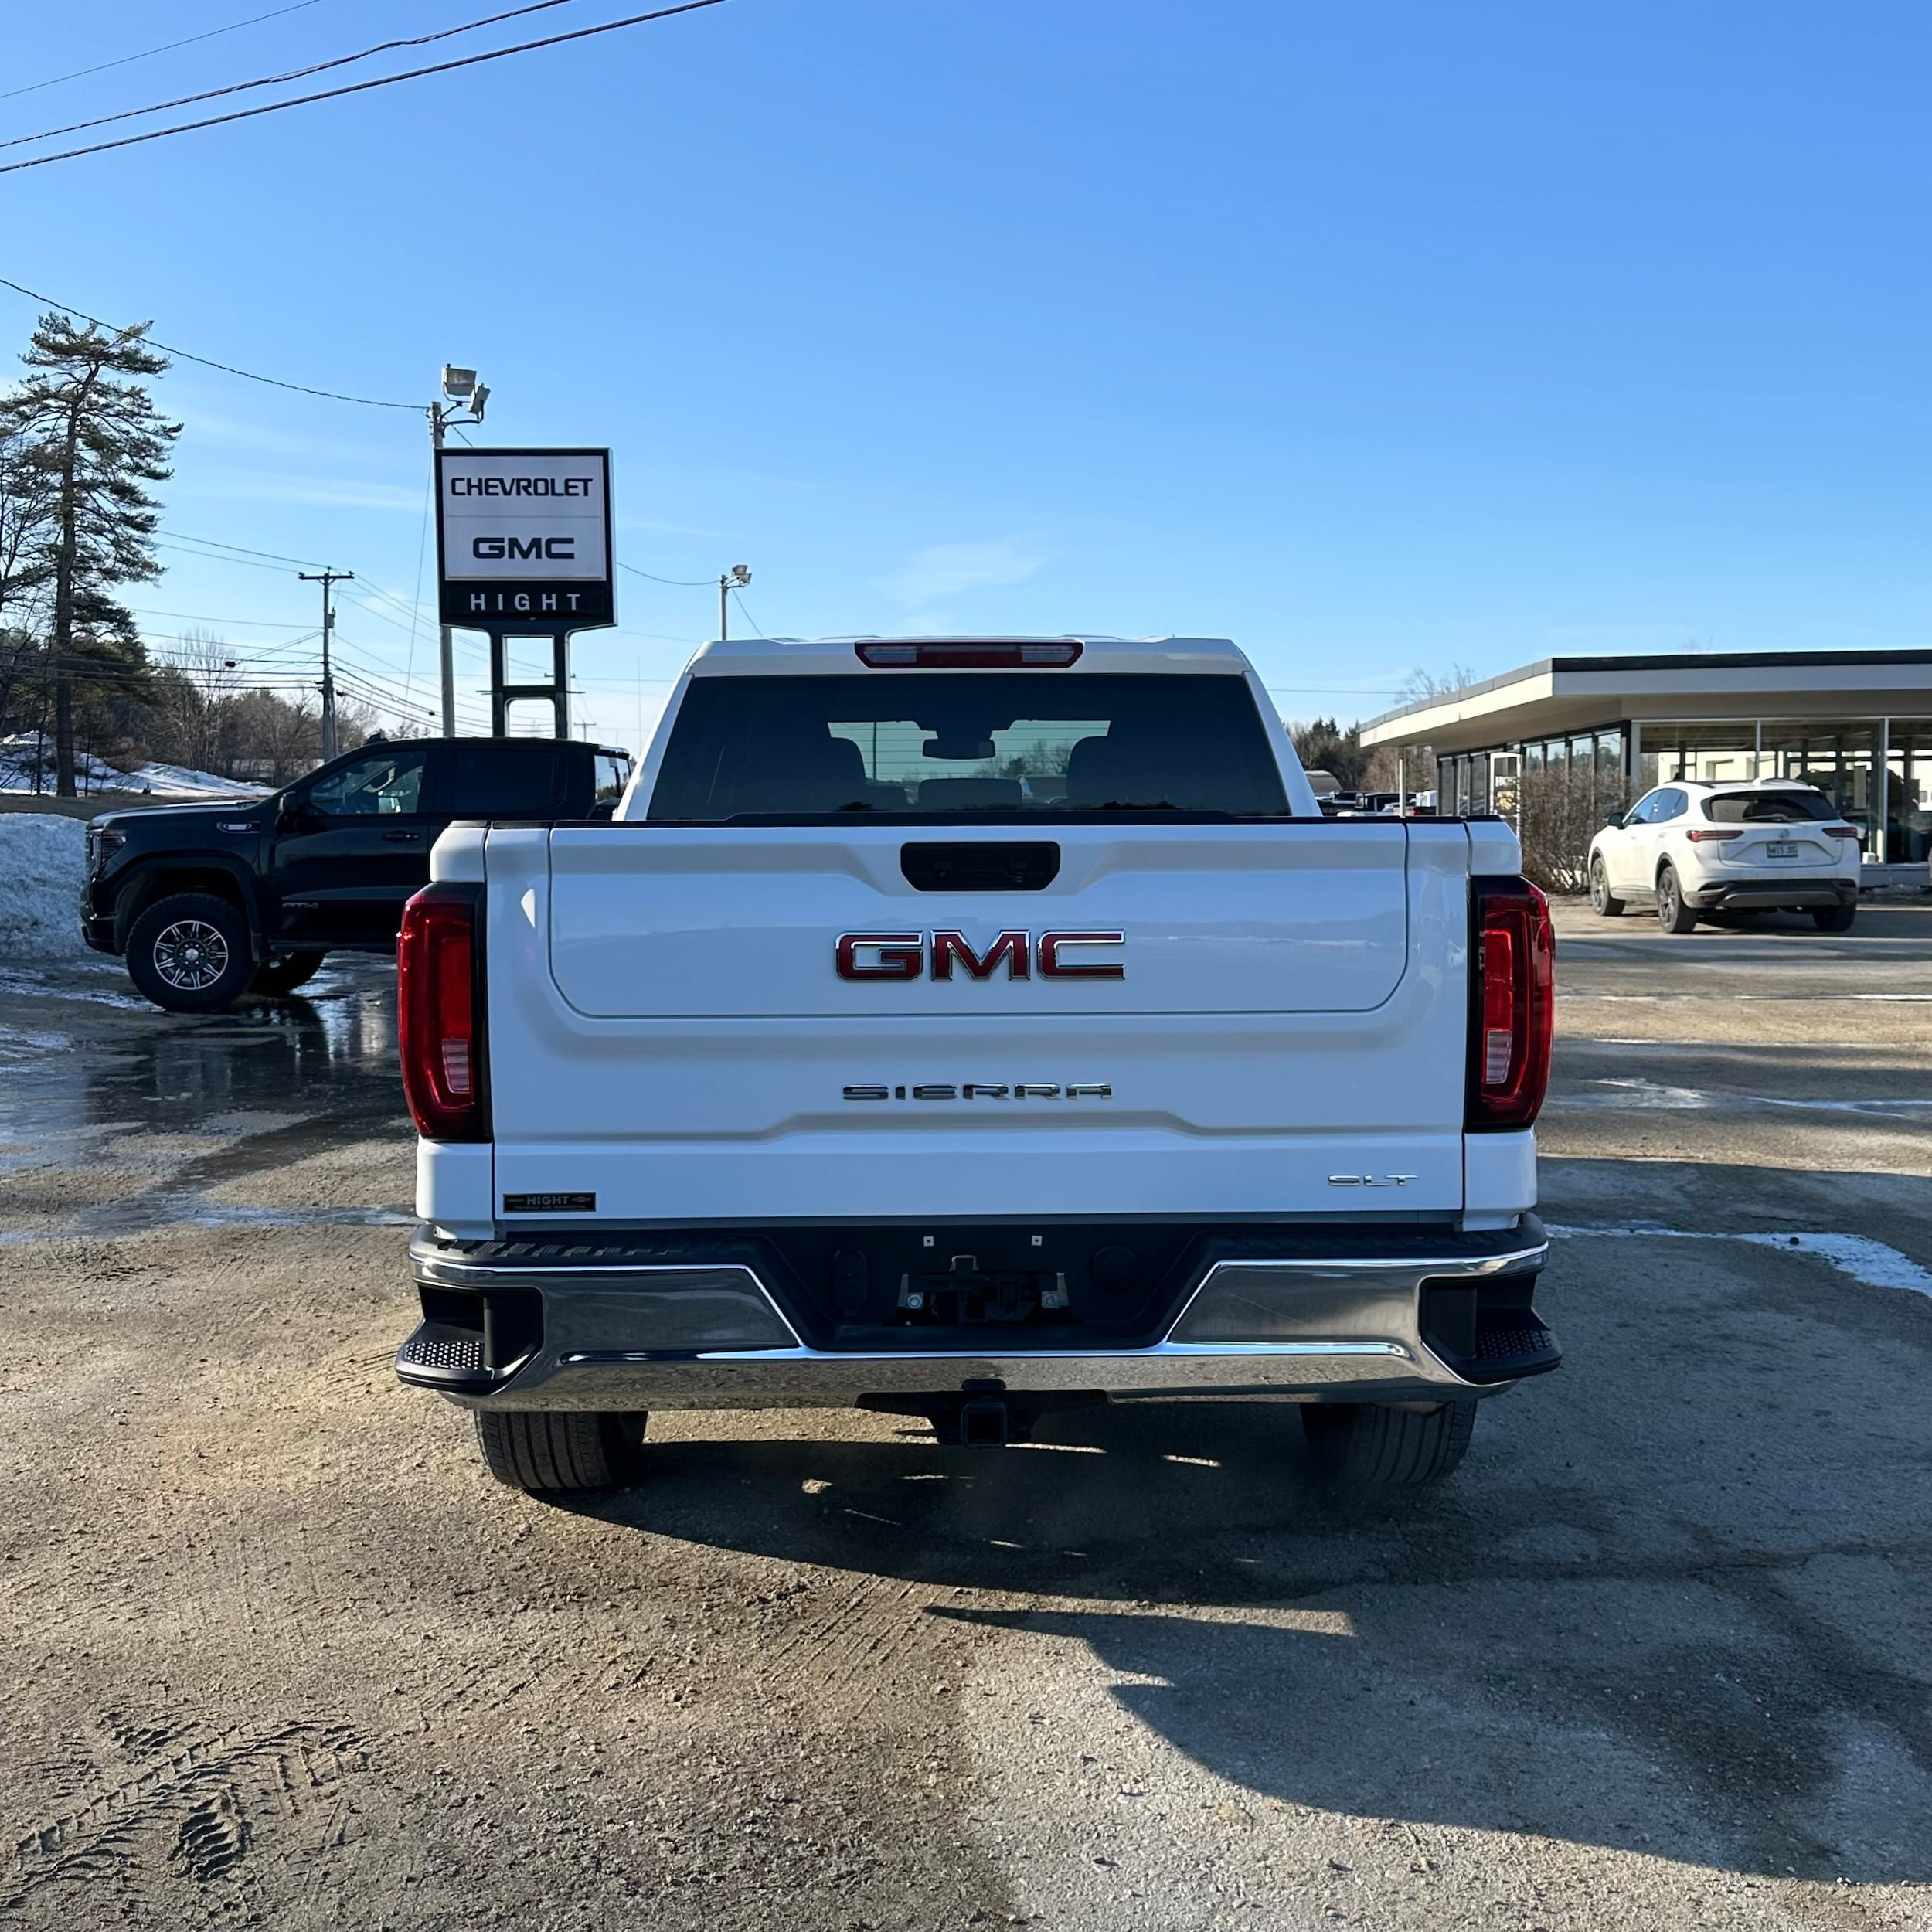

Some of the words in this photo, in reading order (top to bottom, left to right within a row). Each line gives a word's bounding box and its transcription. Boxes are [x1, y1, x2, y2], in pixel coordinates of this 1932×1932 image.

[451, 478, 594, 497] CHEVROLET
[472, 537, 575, 560] GMC
[470, 594, 580, 611] HIGHT
[835, 930, 1126, 982] GMC
[842, 1083, 1113, 1101] SIERRA
[1328, 1175, 1419, 1186] SLT
[526, 1196, 569, 1205] HIGHT
